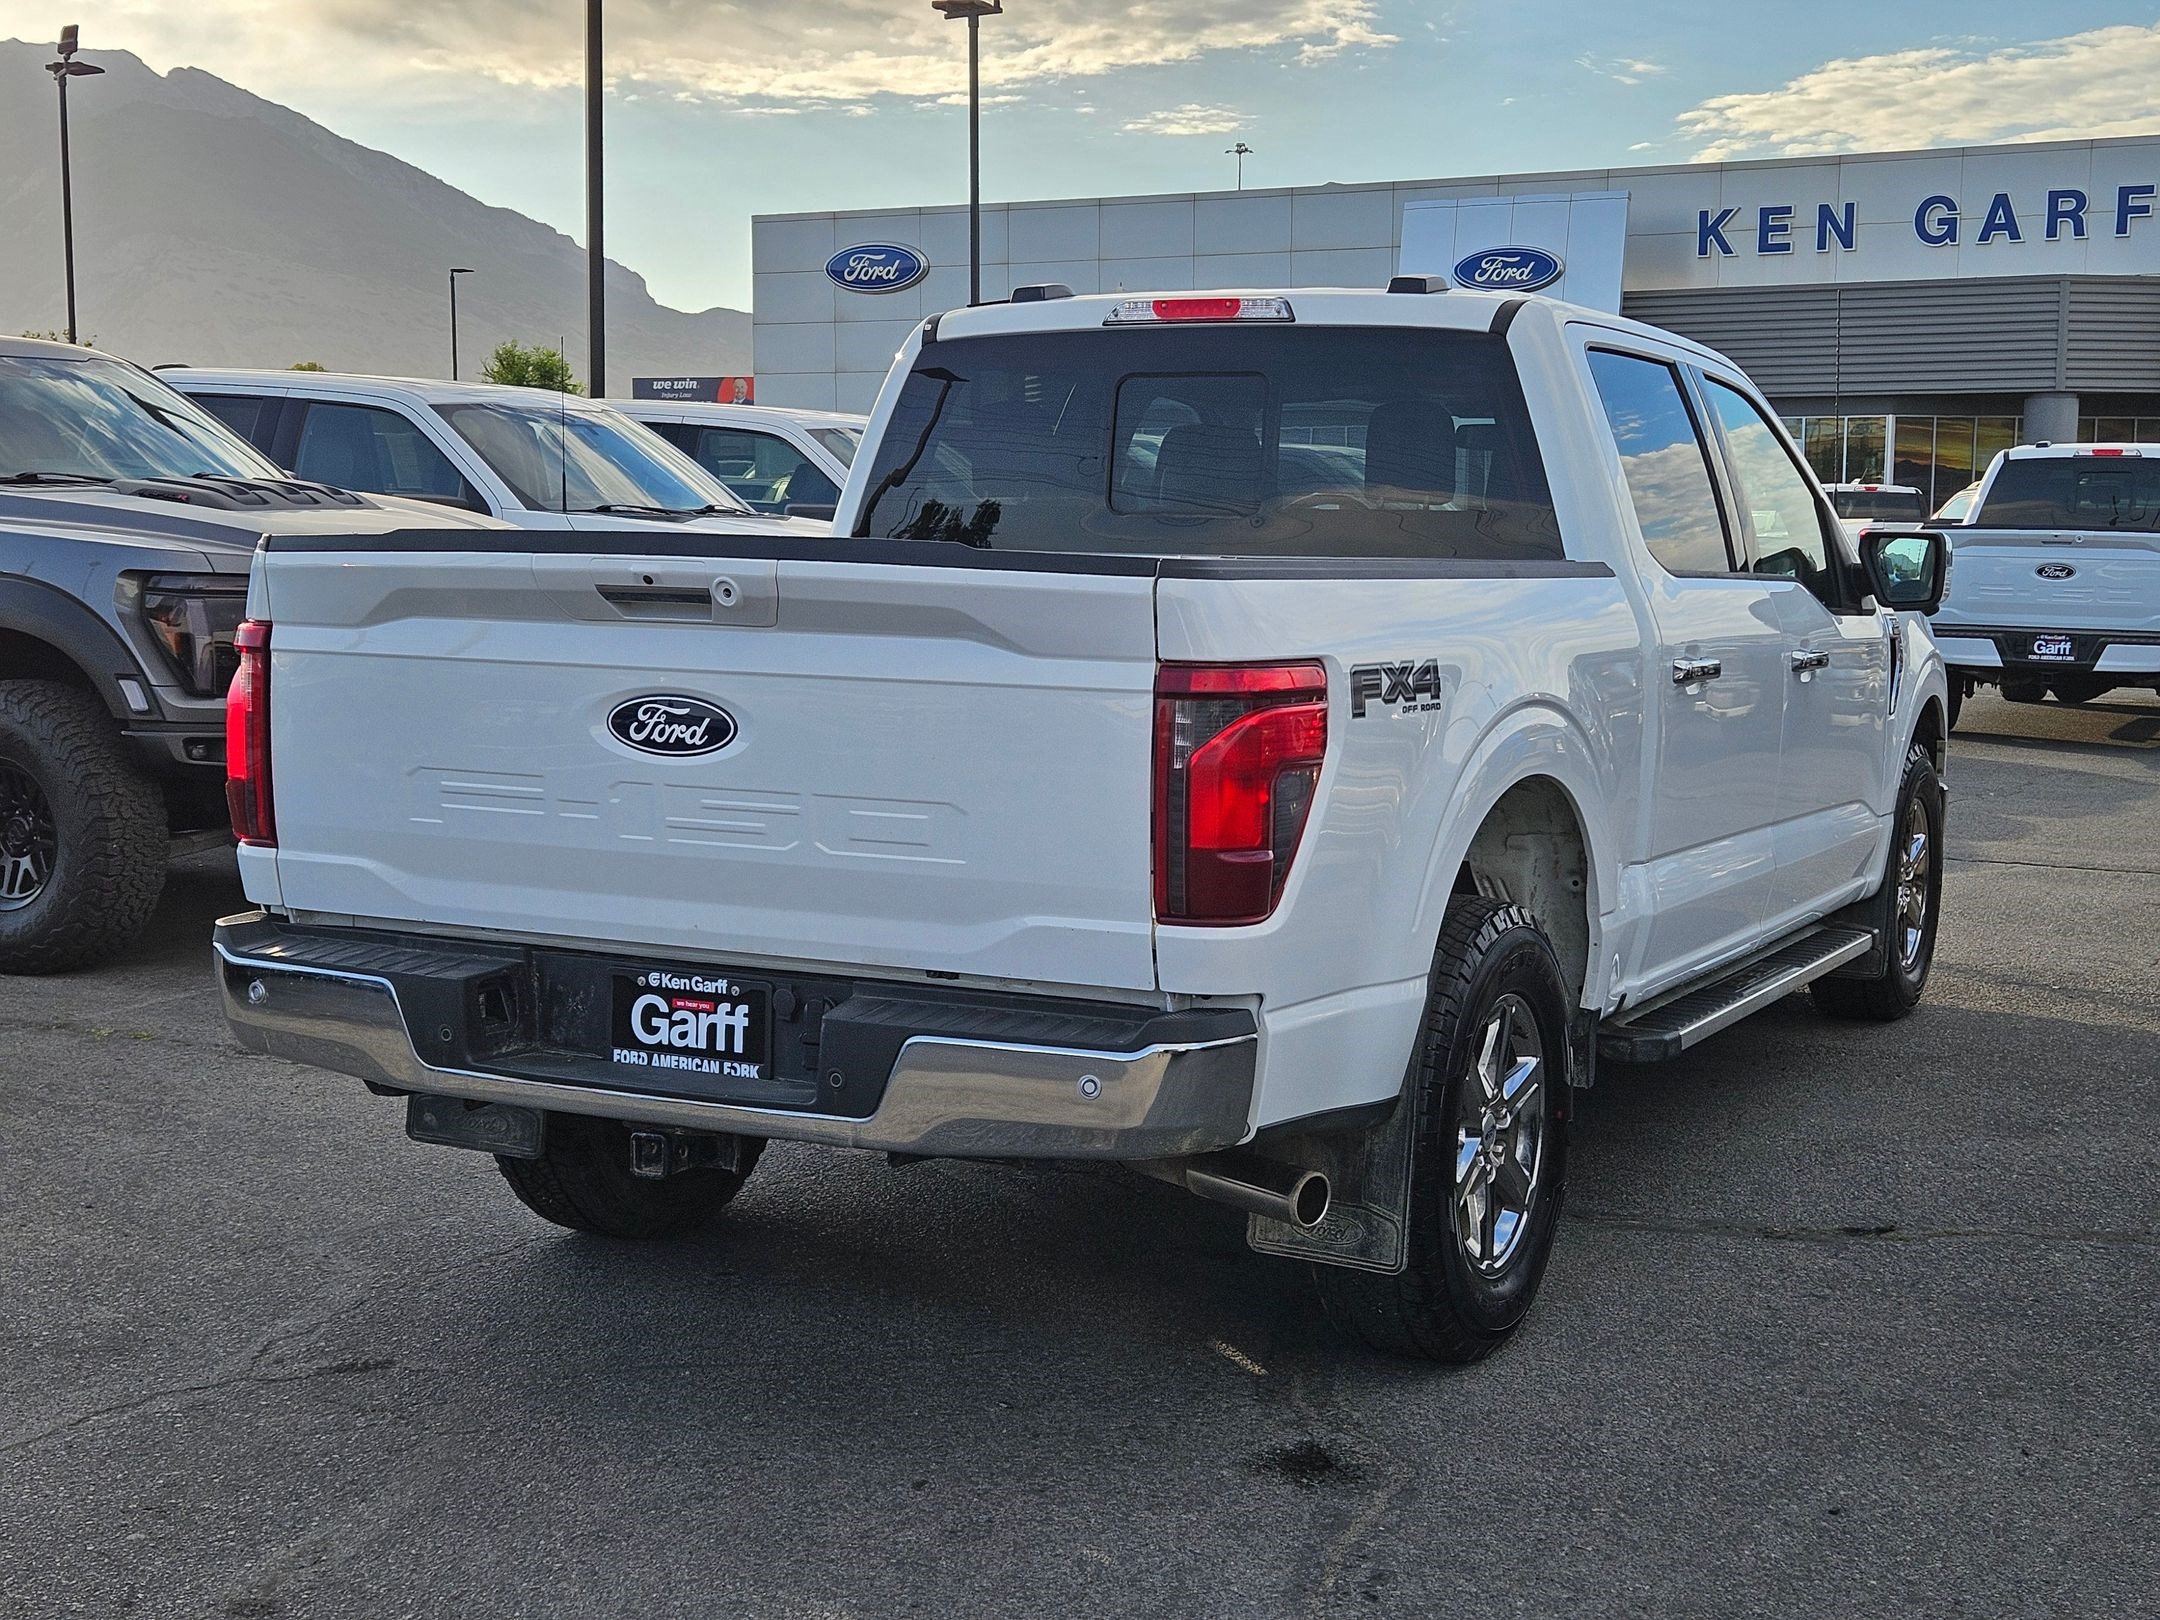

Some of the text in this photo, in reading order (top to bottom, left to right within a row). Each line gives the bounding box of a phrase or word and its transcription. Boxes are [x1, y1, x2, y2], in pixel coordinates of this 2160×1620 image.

[1697, 183, 2157, 258] KEN GARF
[844, 253, 901, 281] Ford
[1475, 256, 1535, 282] Ford
[653, 378, 697, 390] we win
[661, 391, 692, 400] Injury Law
[2042, 566, 2069, 577] Ford
[2033, 640, 2071, 655] Garff
[1350, 658, 1441, 719] FX4
[1402, 702, 1441, 714] OFF ROAD
[629, 703, 711, 746] Ford
[661, 972, 728, 995] Ken Garff
[631, 993, 749, 1054] Garff
[613, 1048, 760, 1079] FORD AMERICAN FORK
